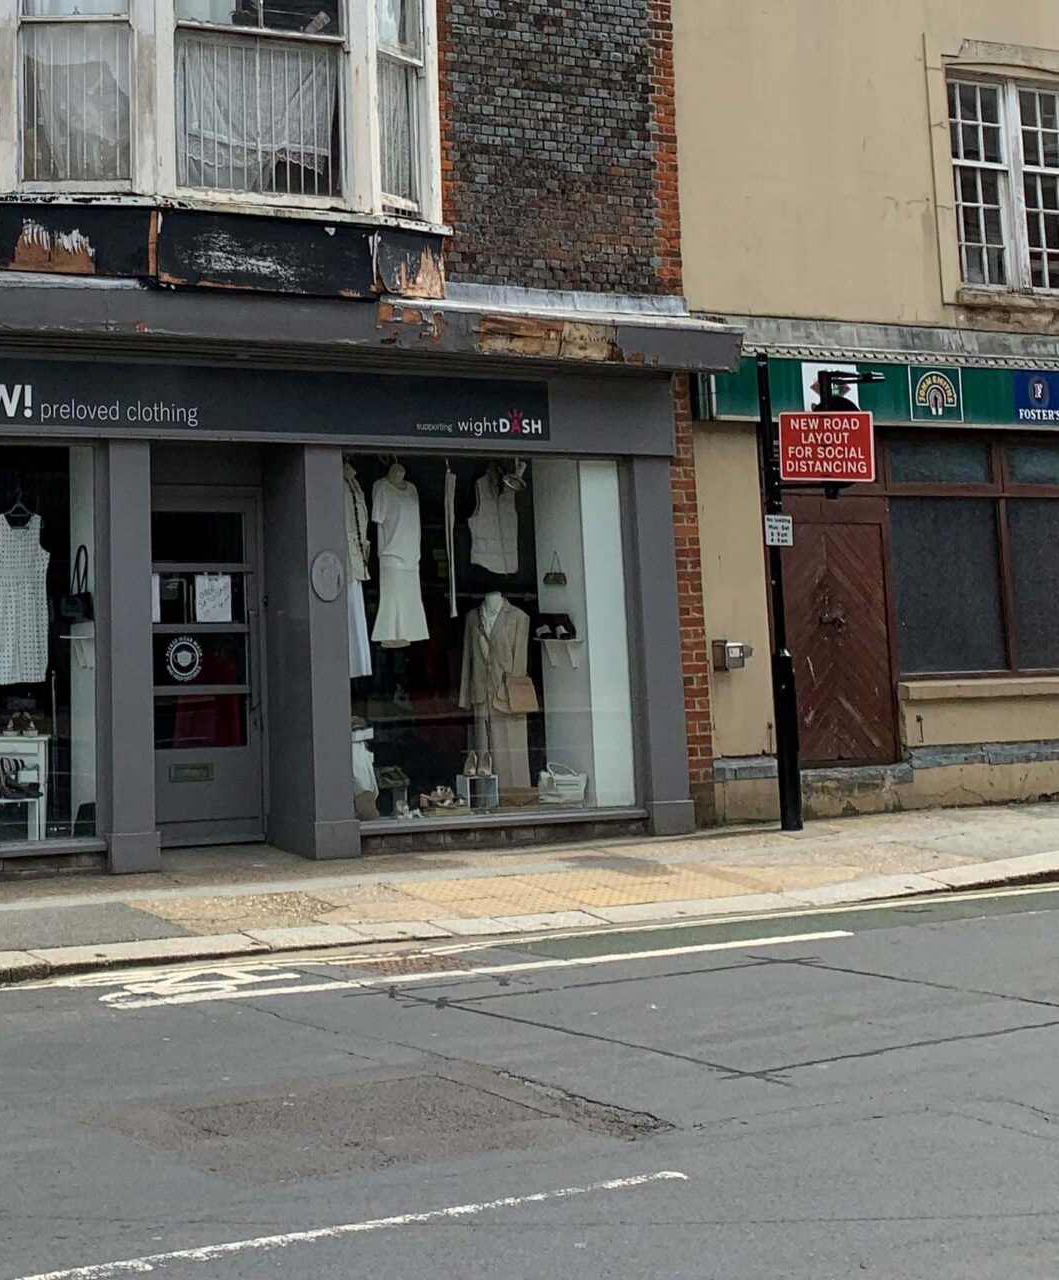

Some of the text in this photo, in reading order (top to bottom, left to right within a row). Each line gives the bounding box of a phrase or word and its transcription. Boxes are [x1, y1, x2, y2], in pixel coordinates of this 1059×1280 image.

[41, 398, 120, 422] preloved
[127, 400, 198, 426] clothing
[416, 416, 542, 437] supporting wightDASH
[790, 418, 860, 430] NEW ROAD
[801, 432, 850, 444] LAYOUT
[788, 446, 865, 459] FOR SOCIAL
[786, 461, 867, 473] DISTANCING
